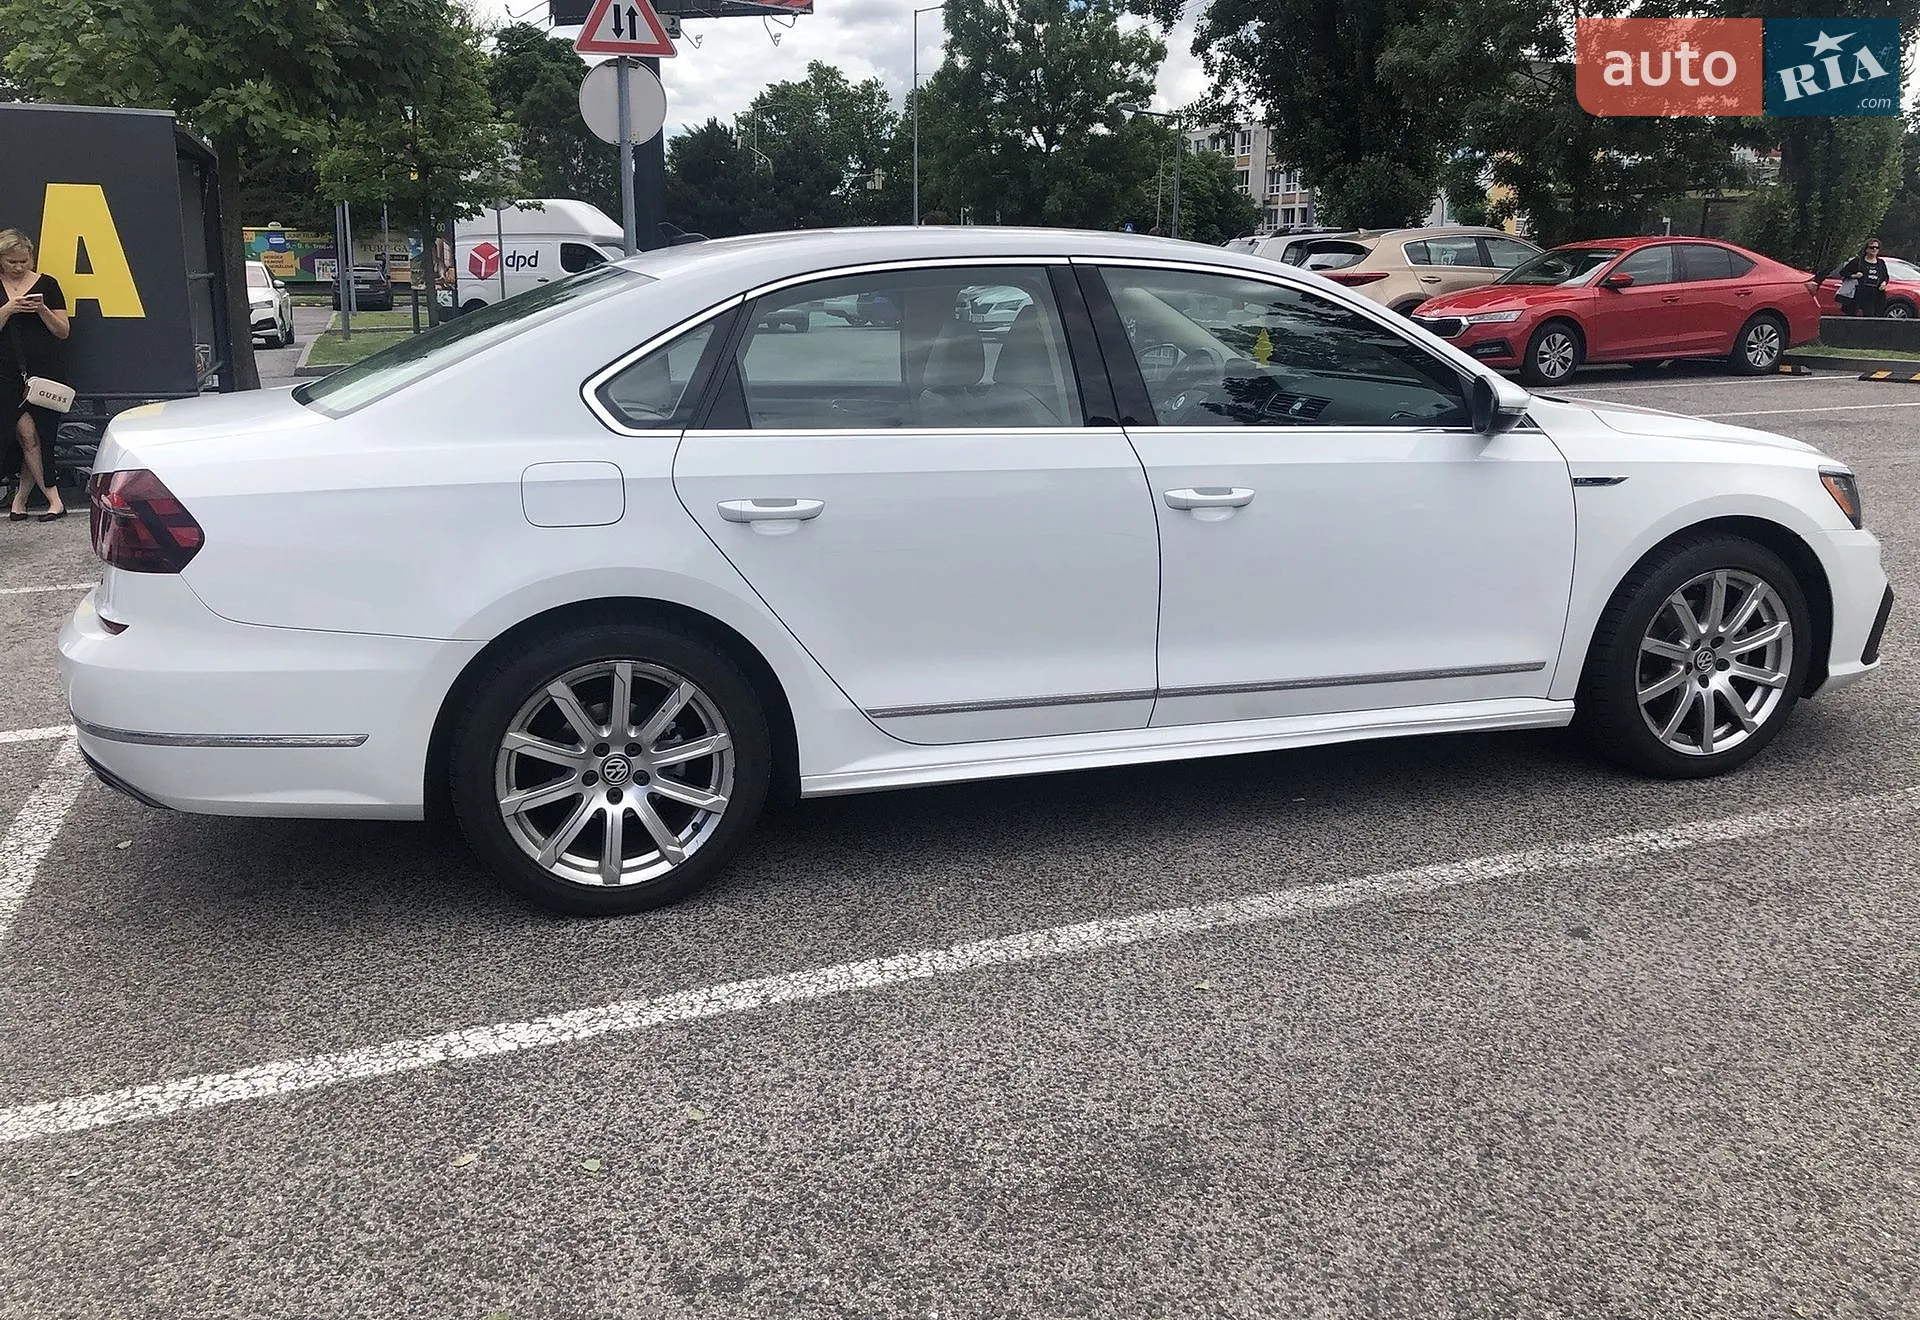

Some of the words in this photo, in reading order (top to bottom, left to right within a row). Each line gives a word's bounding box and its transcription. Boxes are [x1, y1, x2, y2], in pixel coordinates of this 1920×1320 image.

[37, 183, 146, 317] A
[505, 250, 538, 271] dpd
[39, 390, 67, 403] GUESS
